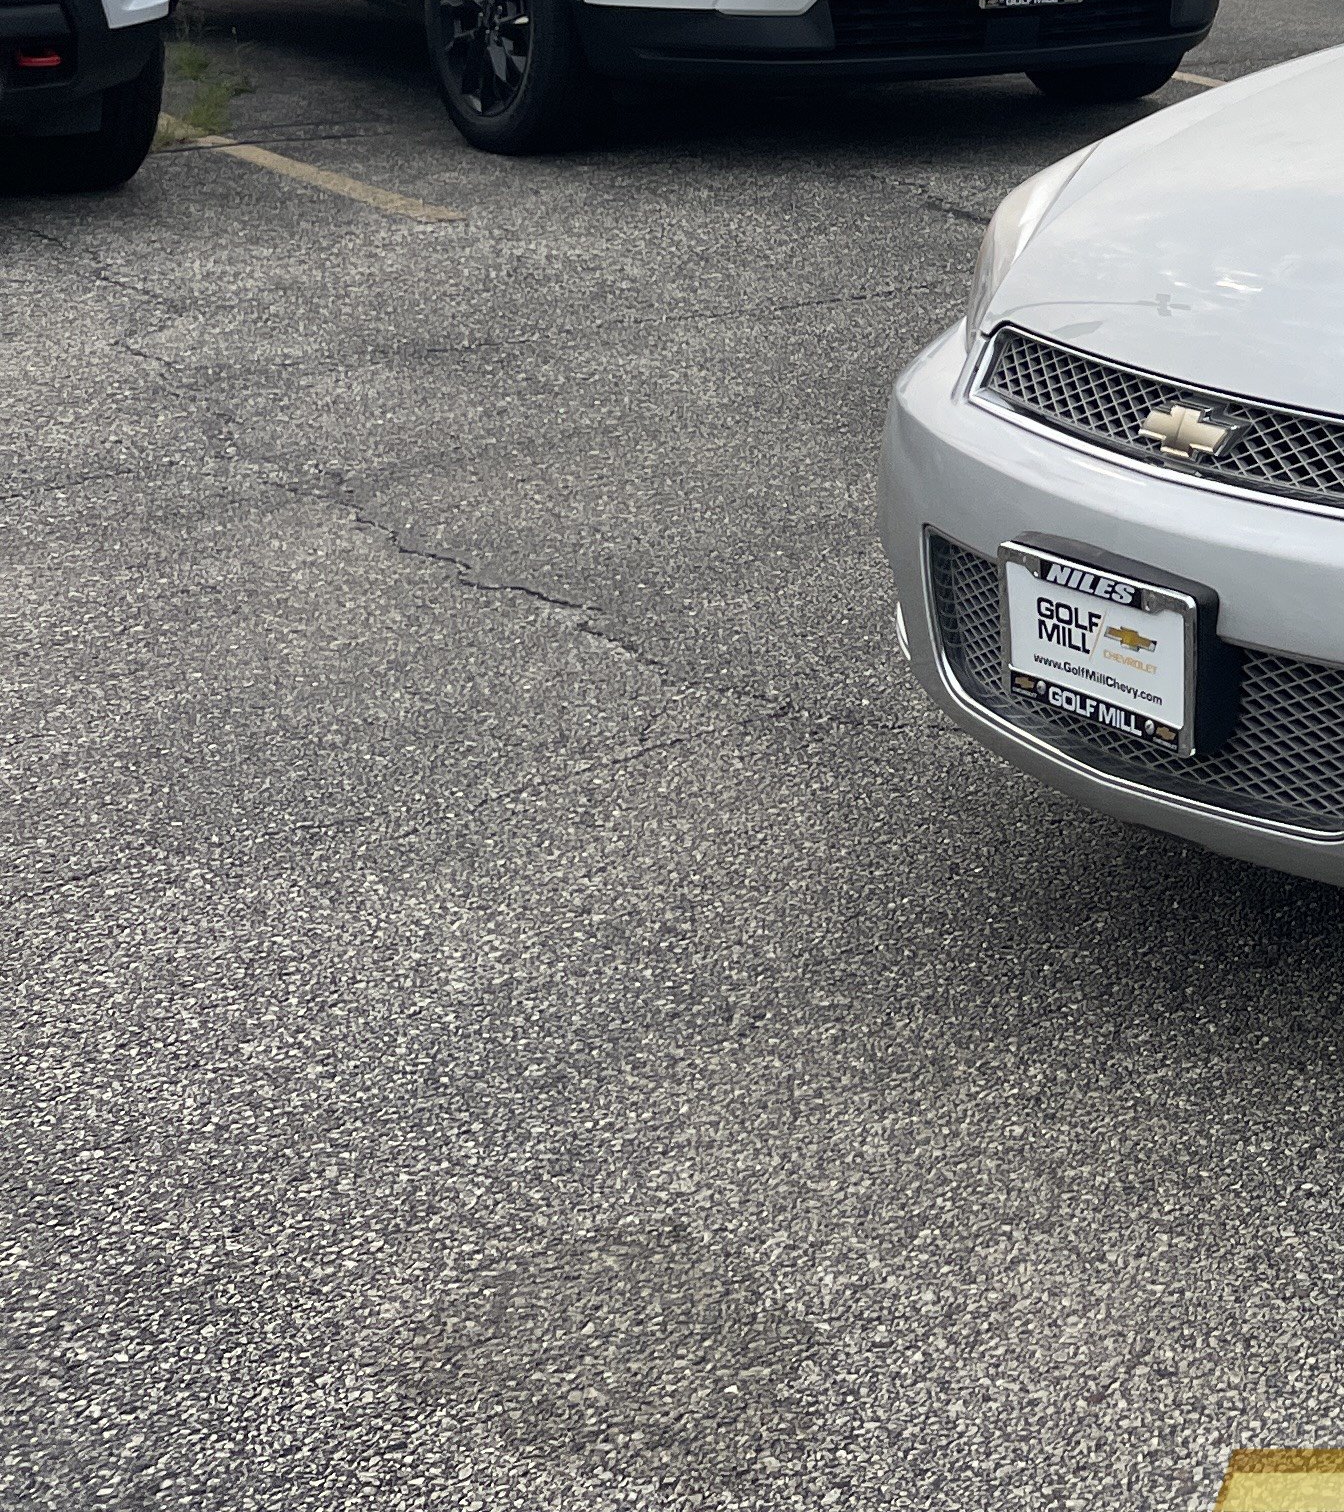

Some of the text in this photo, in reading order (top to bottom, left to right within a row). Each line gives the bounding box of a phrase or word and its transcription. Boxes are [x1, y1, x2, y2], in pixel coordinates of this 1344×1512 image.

[1047, 563, 1136, 604] NILES
[1036, 596, 1102, 633] GOLF
[1037, 619, 1091, 655] MILL
[1033, 653, 1163, 706] www.GolfMillChevy.com
[1103, 649, 1158, 675] CHEVROLET
[1048, 686, 1142, 737] GOLF MILL
